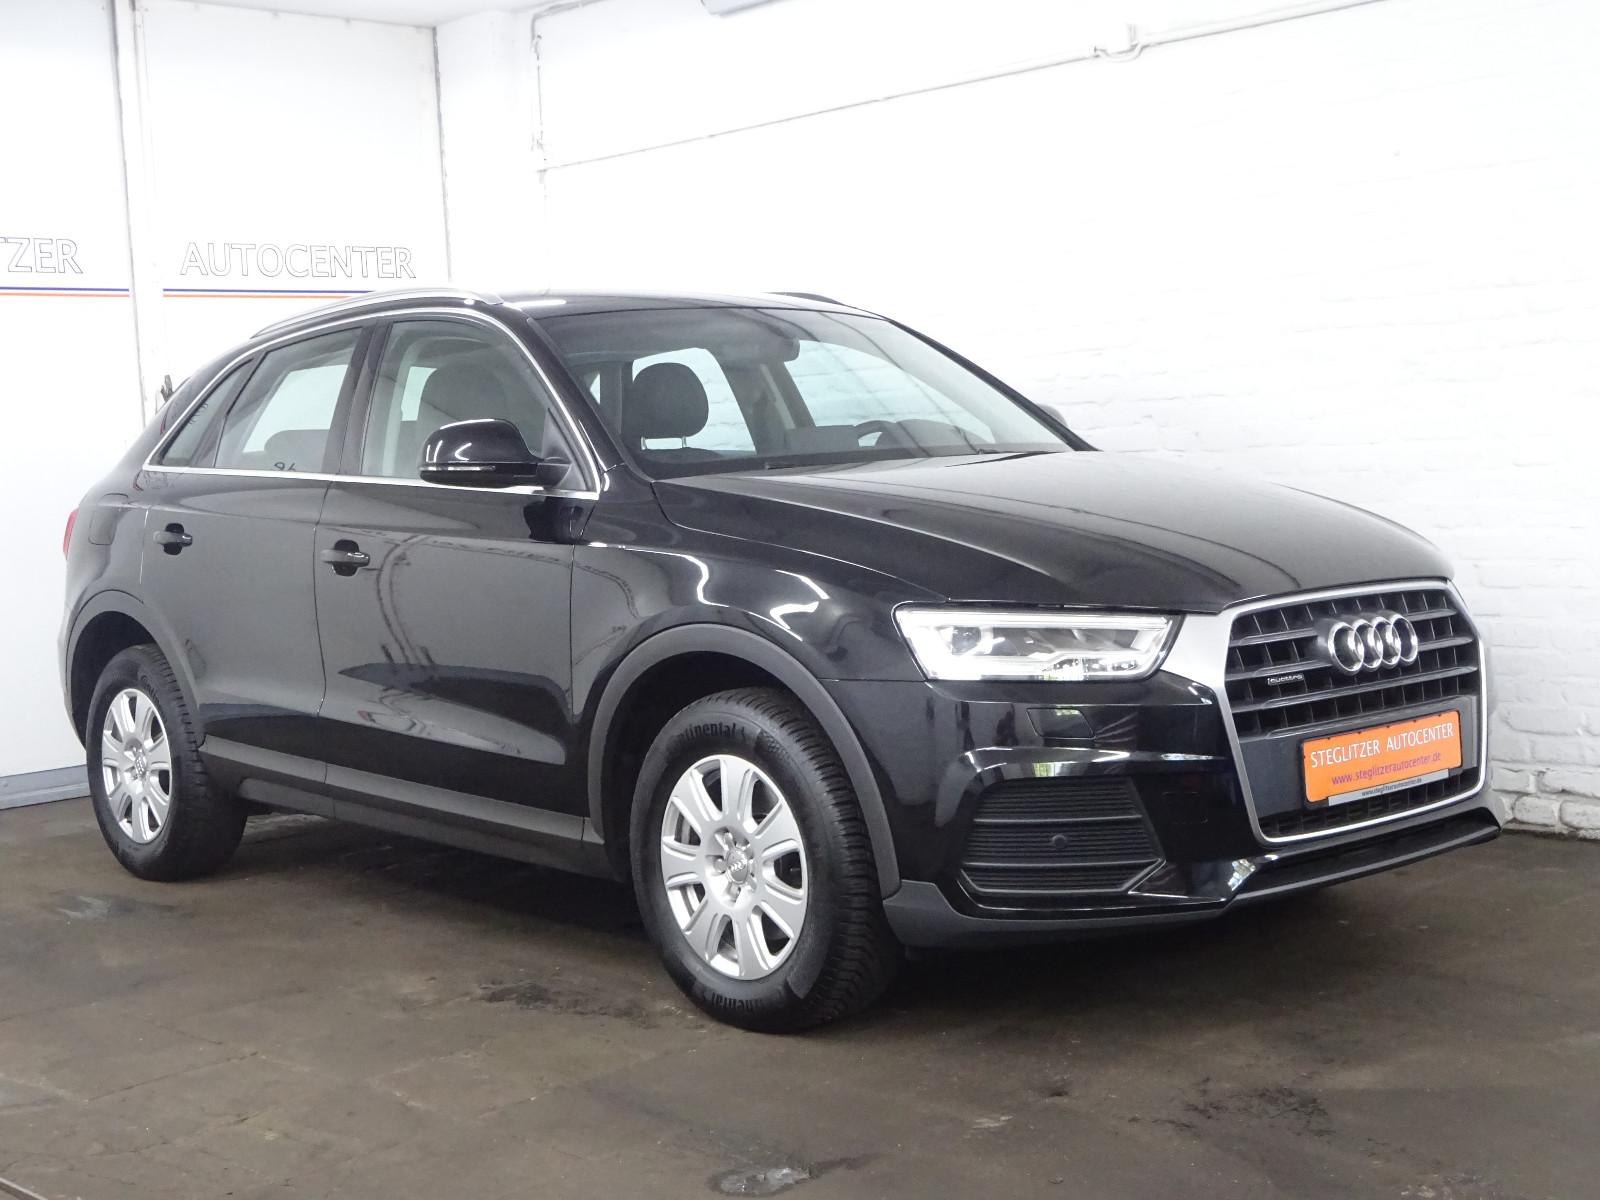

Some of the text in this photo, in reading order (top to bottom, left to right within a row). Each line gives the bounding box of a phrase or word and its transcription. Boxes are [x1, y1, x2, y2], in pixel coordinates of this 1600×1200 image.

[0, 237, 416, 278] ZER AUTOCENTER
[1310, 722, 1454, 768] STEGLITZER AUTOCENTER
[1331, 752, 1442, 785] www.steglitzerautocenter.de
